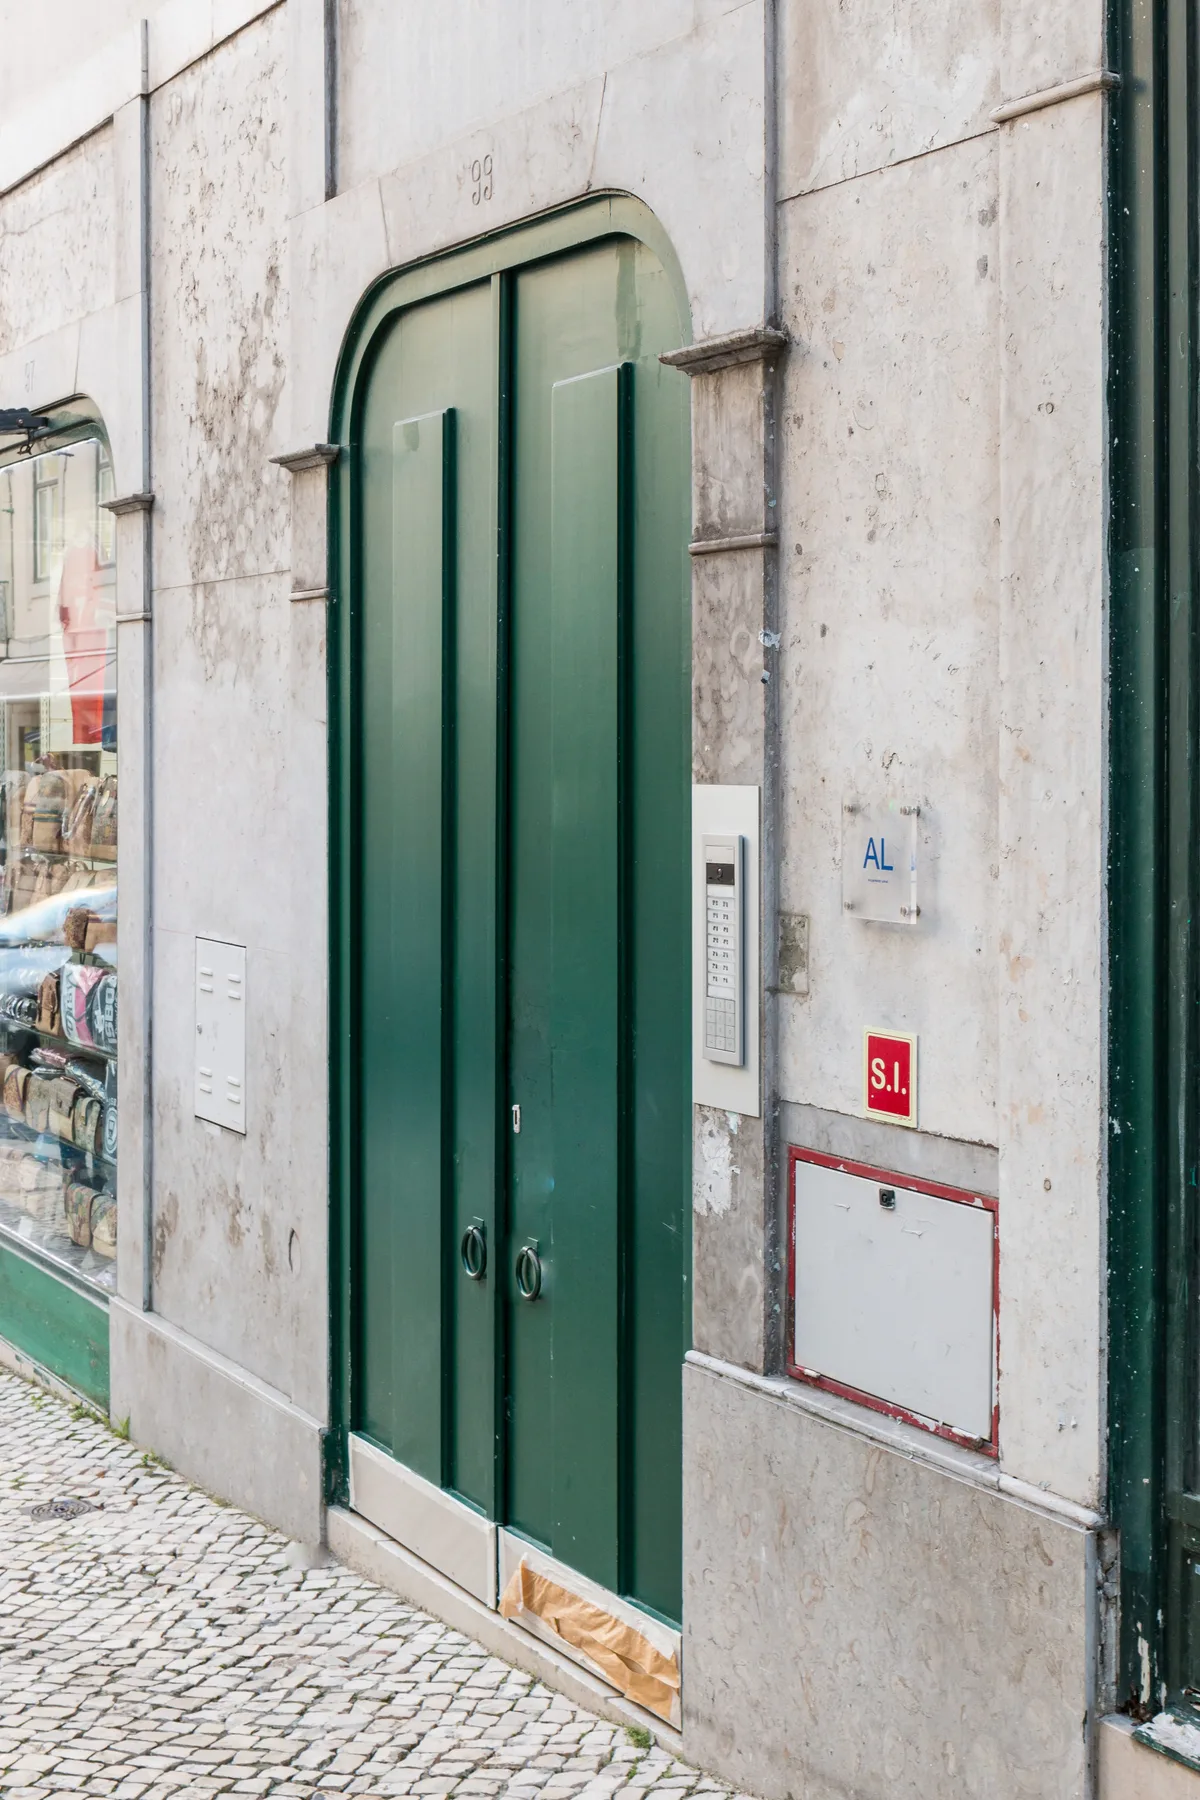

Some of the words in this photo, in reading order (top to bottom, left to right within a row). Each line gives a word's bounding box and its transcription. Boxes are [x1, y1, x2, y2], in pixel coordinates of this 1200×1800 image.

[471, 154, 493, 206] 99
[863, 837, 894, 871] AL
[871, 1057, 907, 1095] S.I.
